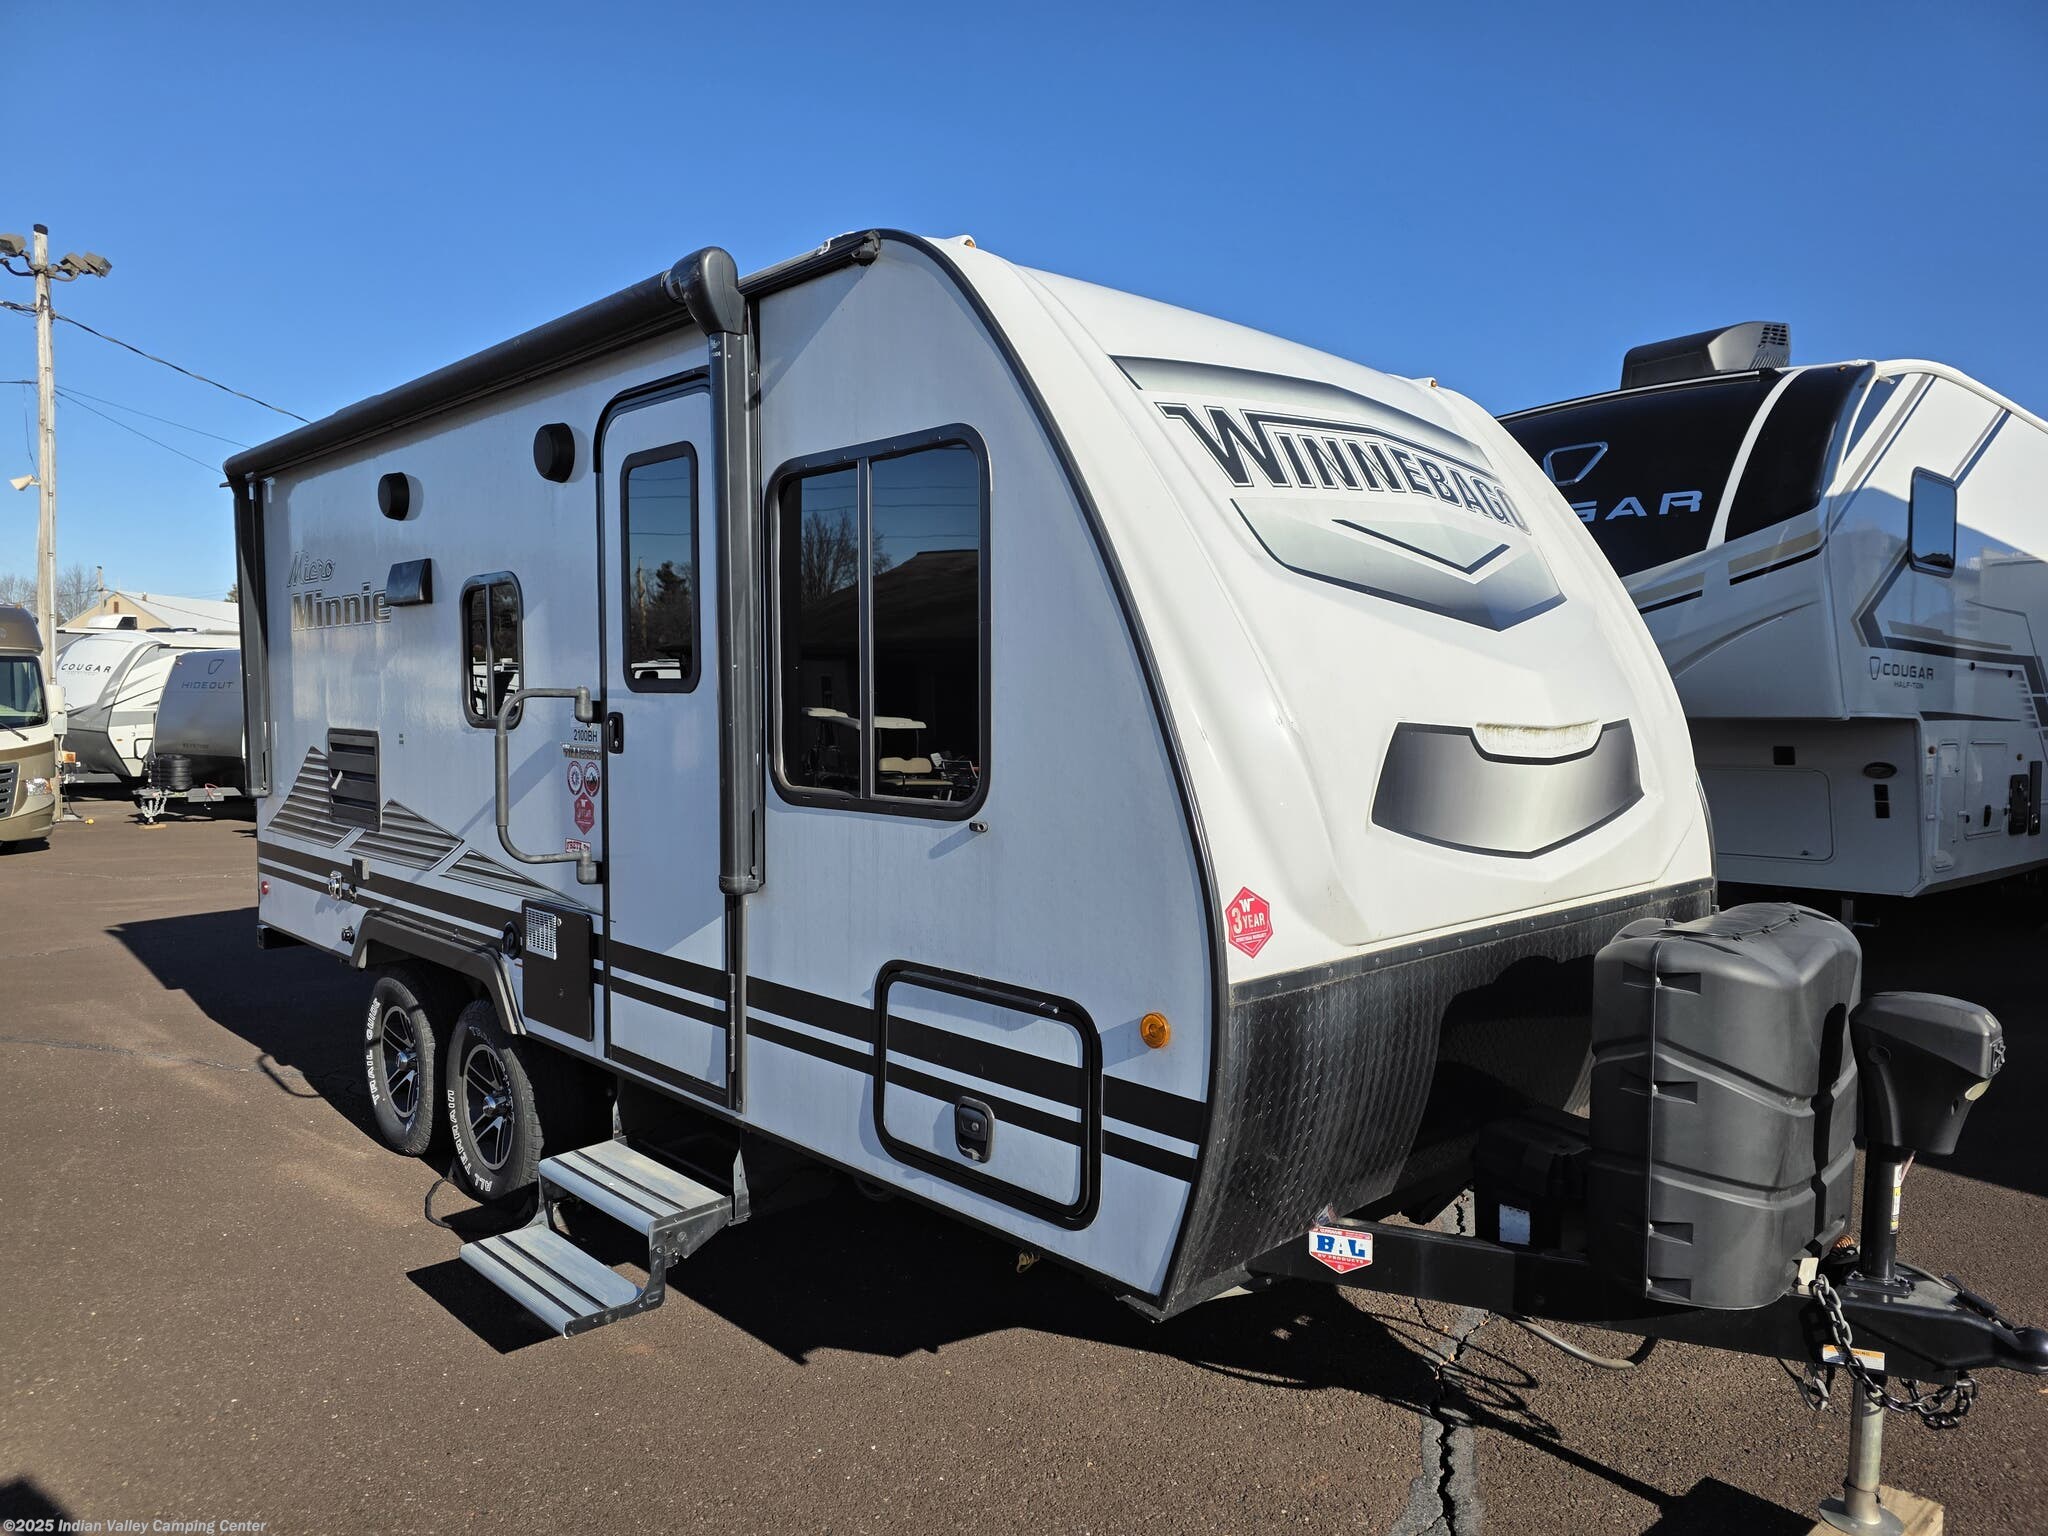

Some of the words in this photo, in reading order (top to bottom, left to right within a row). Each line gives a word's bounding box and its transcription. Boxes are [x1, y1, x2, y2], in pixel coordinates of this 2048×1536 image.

[1154, 402, 1531, 536] WINNEBAGO
[287, 551, 336, 588] Micro
[291, 581, 392, 632] Minnie
[61, 663, 113, 673] COUGAR
[1883, 663, 1934, 680] COUGAR
[181, 681, 234, 690] HIDEOUT
[573, 729, 598, 742] 2100BH
[1231, 907, 1243, 934] 3
[1242, 912, 1265, 929] YEAR
[366, 1049, 380, 1106] TRAIL
[474, 1172, 492, 1192] ALL
